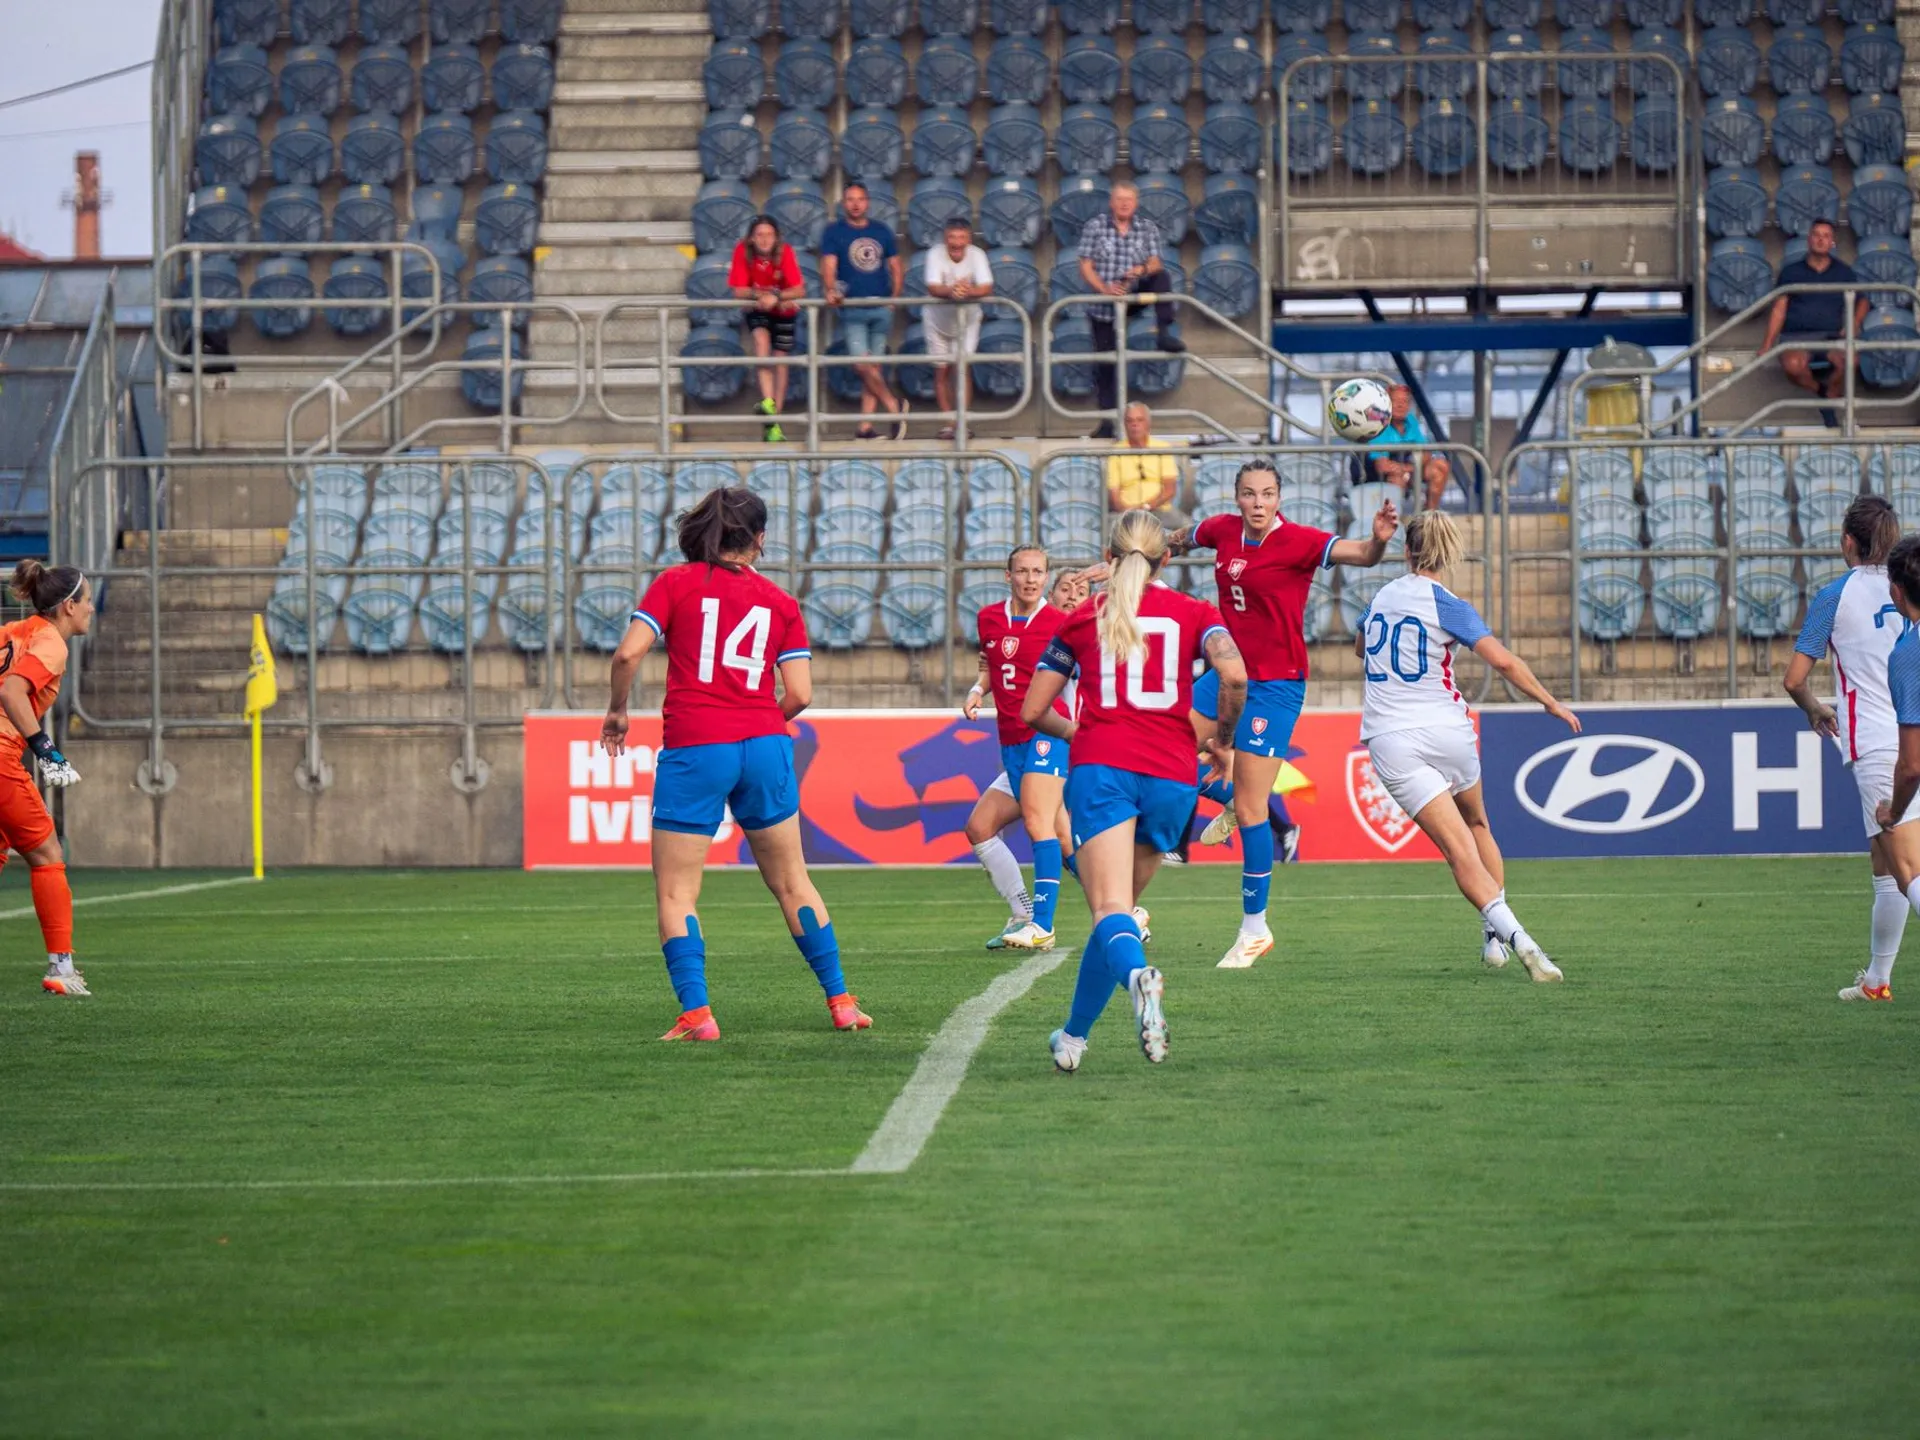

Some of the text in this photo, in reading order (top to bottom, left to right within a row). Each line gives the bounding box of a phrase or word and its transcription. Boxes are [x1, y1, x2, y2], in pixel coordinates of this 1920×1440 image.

[1230, 585, 1247, 612] 9
[698, 597, 772, 691] 14
[1100, 616, 1181, 710] 10
[1365, 612, 1428, 682] 20
[1001, 663, 1017, 690] 2
[569, 740, 664, 788] Hr
